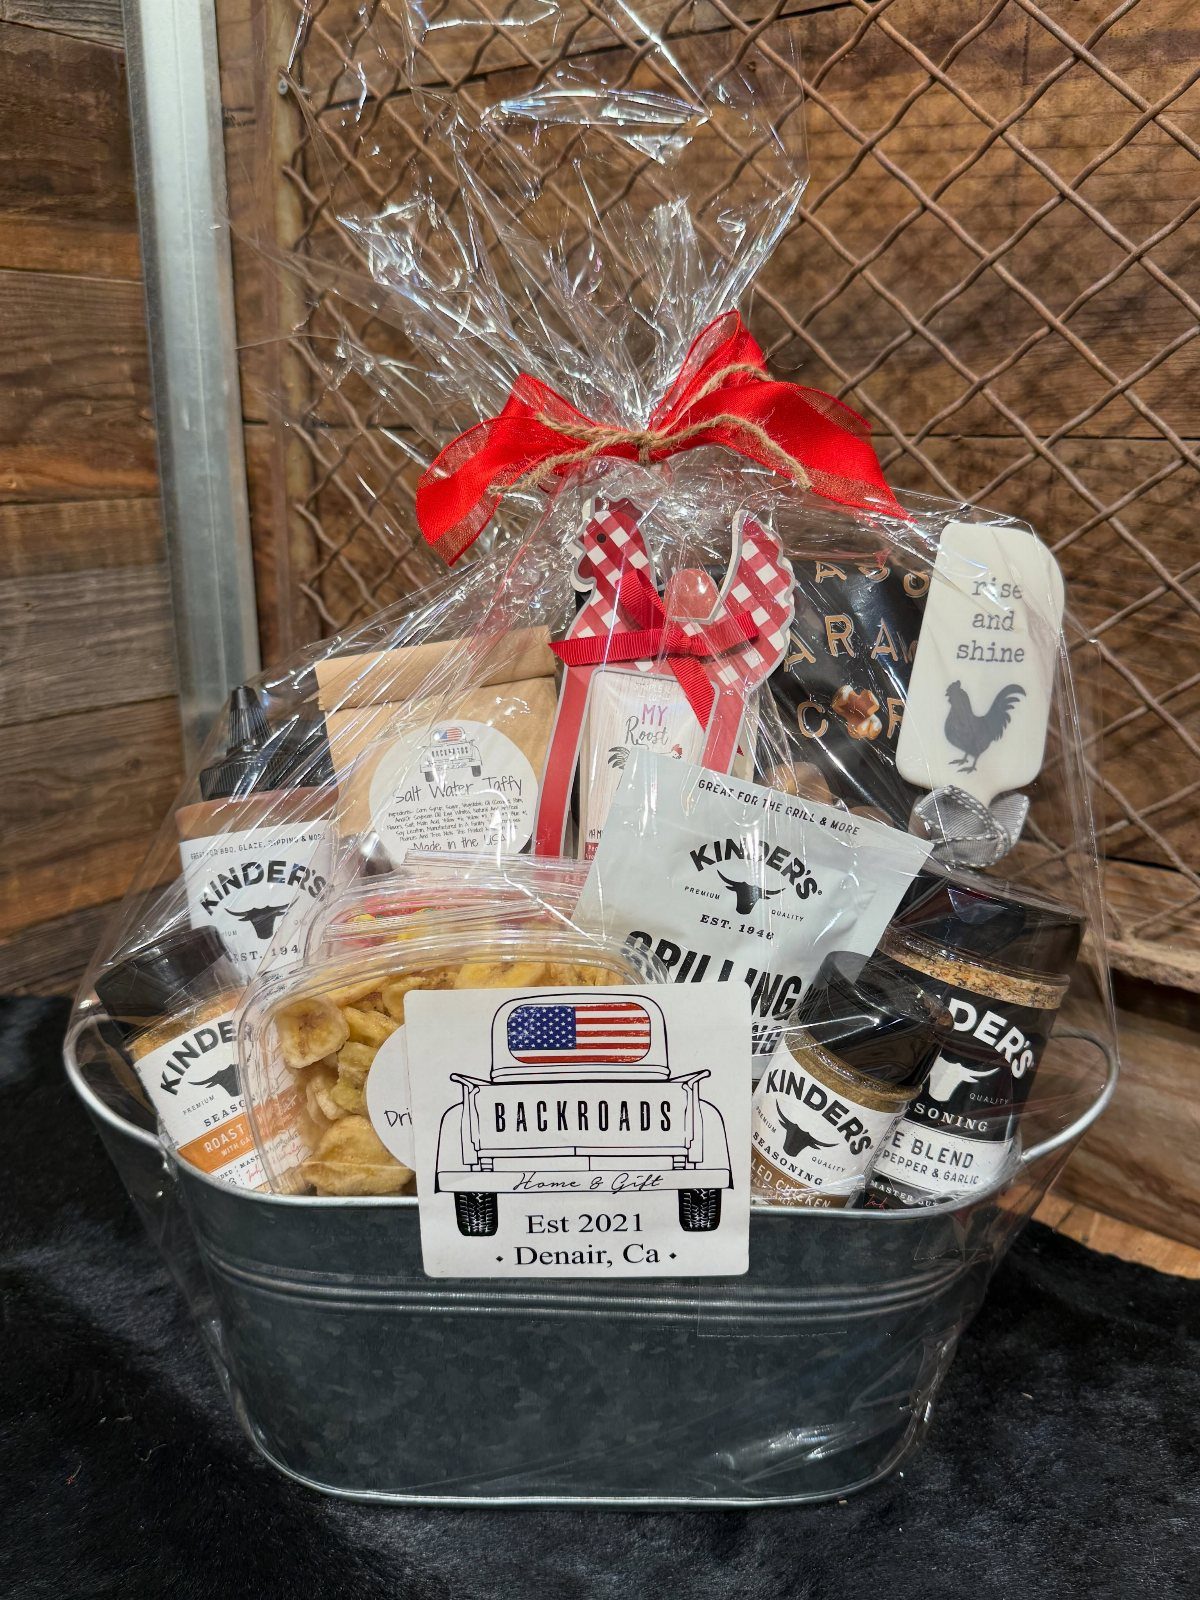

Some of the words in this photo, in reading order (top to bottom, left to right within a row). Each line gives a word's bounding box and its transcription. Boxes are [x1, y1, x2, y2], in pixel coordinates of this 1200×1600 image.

[972, 577, 1022, 598] rise
[972, 611, 1015, 631] and
[956, 641, 1025, 663] shine
[641, 703, 668, 727] MY
[624, 715, 669, 747] Roost
[394, 785, 421, 804] Salt
[428, 781, 474, 799] Water
[481, 775, 523, 797] Taffy
[697, 778, 733, 799] GREAT
[737, 790, 759, 805] FOR
[762, 797, 783, 813] THE
[785, 805, 815, 823] GRILL
[819, 816, 828, 827] &
[830, 819, 860, 837] MORE
[411, 840, 441, 850] Made
[447, 838, 457, 849] in
[461, 836, 479, 848] the
[688, 838, 818, 901] KINDER'S
[200, 859, 327, 917] KINDER'S
[684, 885, 721, 901] PREMIUM
[699, 914, 732, 931] EST.
[770, 908, 805, 923] QUALITY
[271, 944, 299, 957] 194
[948, 997, 1034, 1079] DER'S
[160, 1020, 238, 1096] KINDE
[969, 1092, 1009, 1105] QUALITY
[203, 1099, 248, 1128] SEASO
[384, 1108, 412, 1128] Dri
[494, 1099, 672, 1132] BACKROADS
[755, 1105, 778, 1134] PREMIUM
[765, 1068, 873, 1156] KINDER'S
[913, 1102, 989, 1133] SONING
[239, 1154, 259, 1169] MAST
[752, 1132, 823, 1186] SEASONING
[811, 1156, 846, 1173] QUALITY
[910, 1138, 974, 1169] BLEND
[882, 1149, 928, 1175] PEPPER
[931, 1168, 939, 1178] &
[943, 1171, 979, 1185] GARLIC
[513, 1172, 582, 1192] Home
[590, 1177, 603, 1190] &
[611, 1173, 665, 1195] Gift
[525, 1214, 569, 1235] Est
[578, 1213, 643, 1233] 2021
[513, 1244, 614, 1268] Denair,
[623, 1243, 661, 1265] Ca
